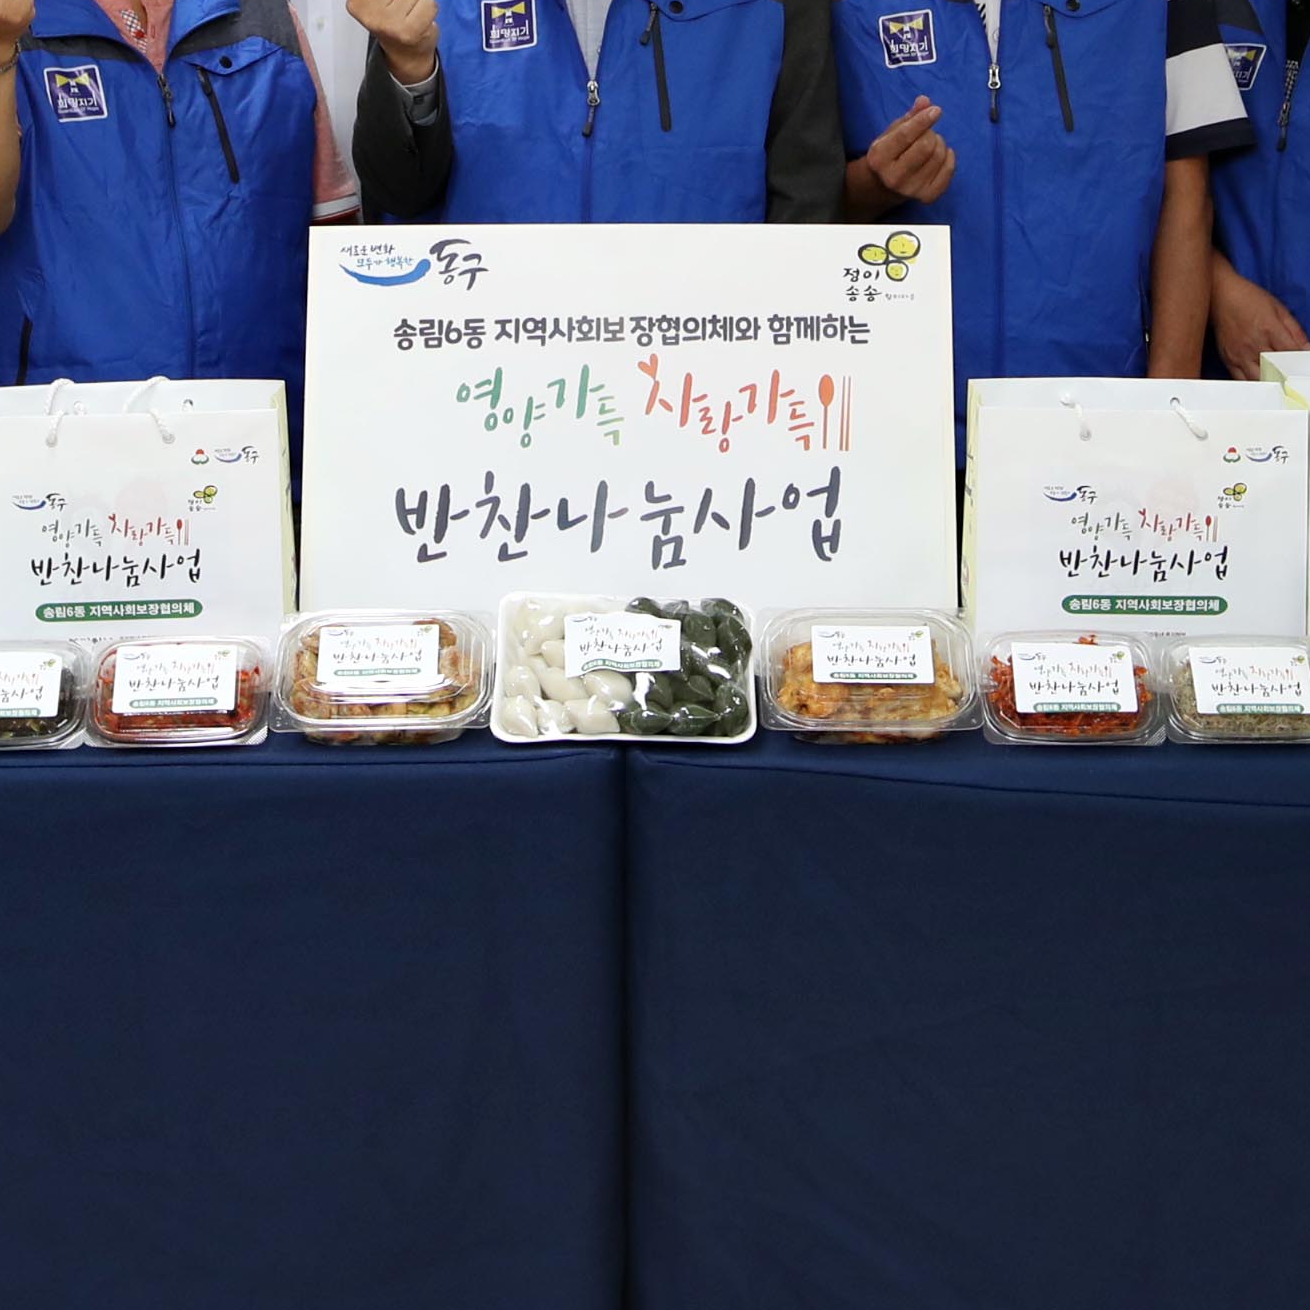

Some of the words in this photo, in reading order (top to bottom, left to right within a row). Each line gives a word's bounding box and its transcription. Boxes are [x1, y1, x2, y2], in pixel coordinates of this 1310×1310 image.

[489, 19, 529, 39] 희망지기
[340, 244, 368, 256] 새로운
[370, 243, 395, 256] 변화
[356, 257, 383, 270] 모두가
[385, 256, 414, 270] 행복한
[429, 238, 490, 292] 동구
[842, 267, 881, 283] 정이
[845, 284, 883, 302] 송송
[393, 317, 487, 351] 송림6동
[494, 315, 762, 347] 지역사회보장협의체와
[768, 313, 871, 345] 함께하는
[456, 364, 625, 448] 영양가득
[637, 352, 815, 454] 사랑가득
[41, 518, 103, 547] 영양가득
[394, 466, 844, 572] 반찬나눔사업
[1070, 511, 1133, 541] 영양가득
[31, 548, 201, 588] 반찬나눔사업
[1059, 545, 1229, 583] 반찬나눔사업
[1068, 598, 1112, 613] 송림6동
[1115, 597, 1220, 613] 지역사회보장협의체
